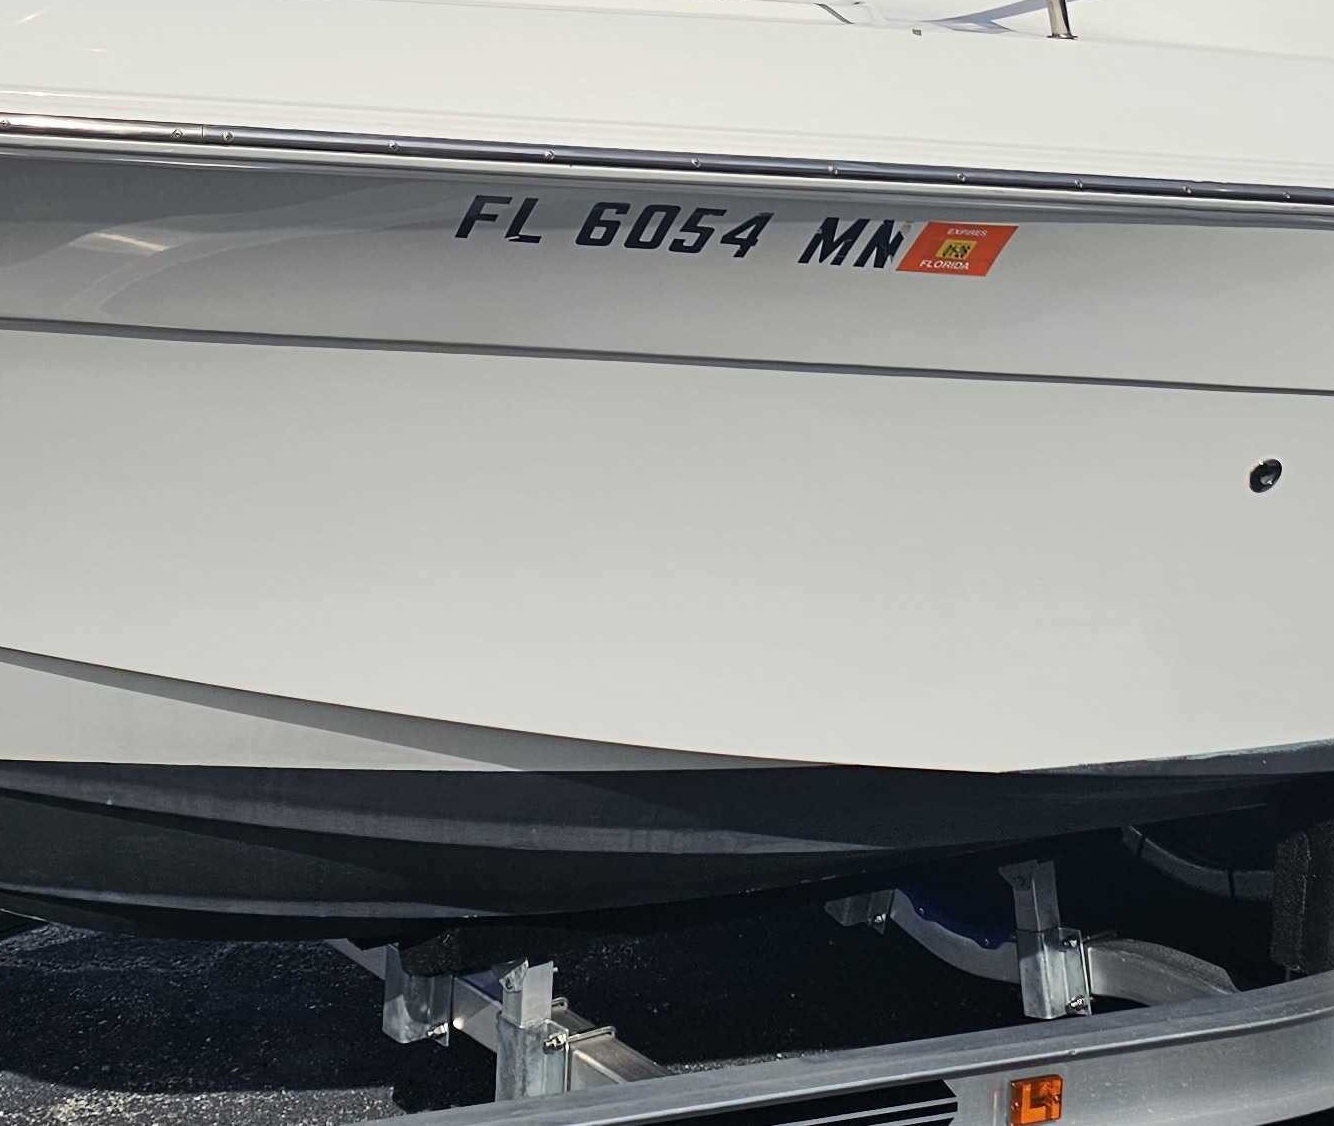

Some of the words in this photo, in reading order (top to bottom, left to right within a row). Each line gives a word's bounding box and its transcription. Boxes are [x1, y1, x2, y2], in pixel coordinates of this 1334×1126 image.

[455, 195, 542, 244] FL
[575, 202, 774, 258] 6054
[797, 217, 913, 269] MN
[947, 228, 988, 237] EXPIRES
[919, 259, 970, 270] FLORIDA
